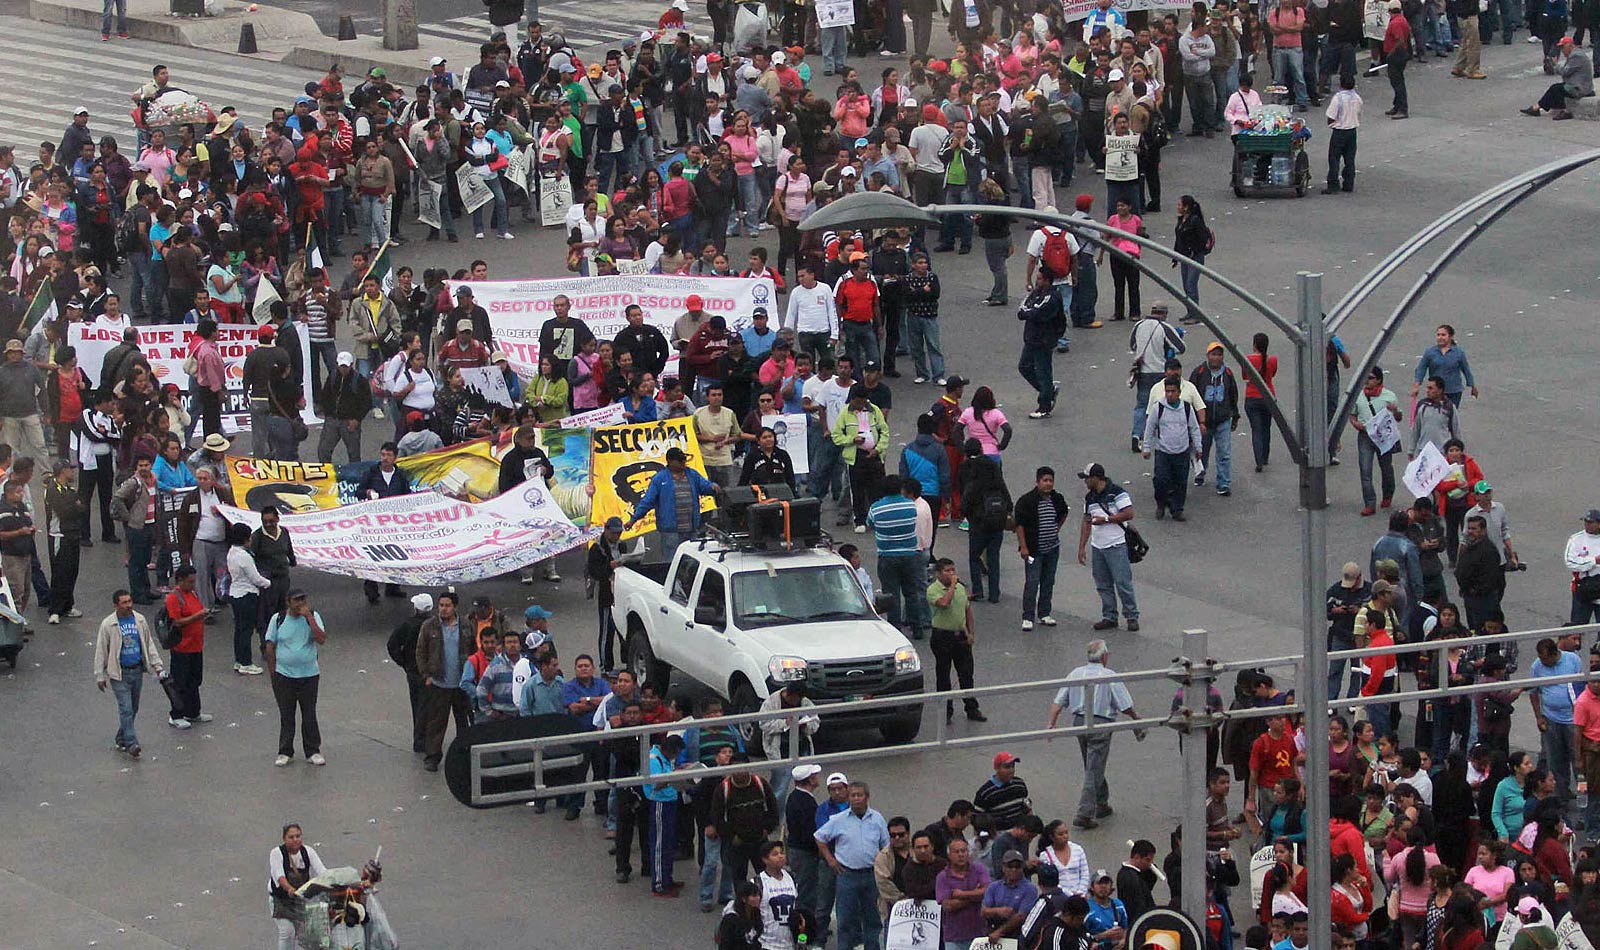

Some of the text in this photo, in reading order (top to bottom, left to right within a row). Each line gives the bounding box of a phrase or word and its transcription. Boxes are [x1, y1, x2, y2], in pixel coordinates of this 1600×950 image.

[637, 295, 737, 311] ESCOIDO
[81, 327, 123, 343] LOS
[183, 329, 260, 343] MENT
[594, 421, 689, 454] SECCIÓN
[361, 543, 409, 563] ¡NO
